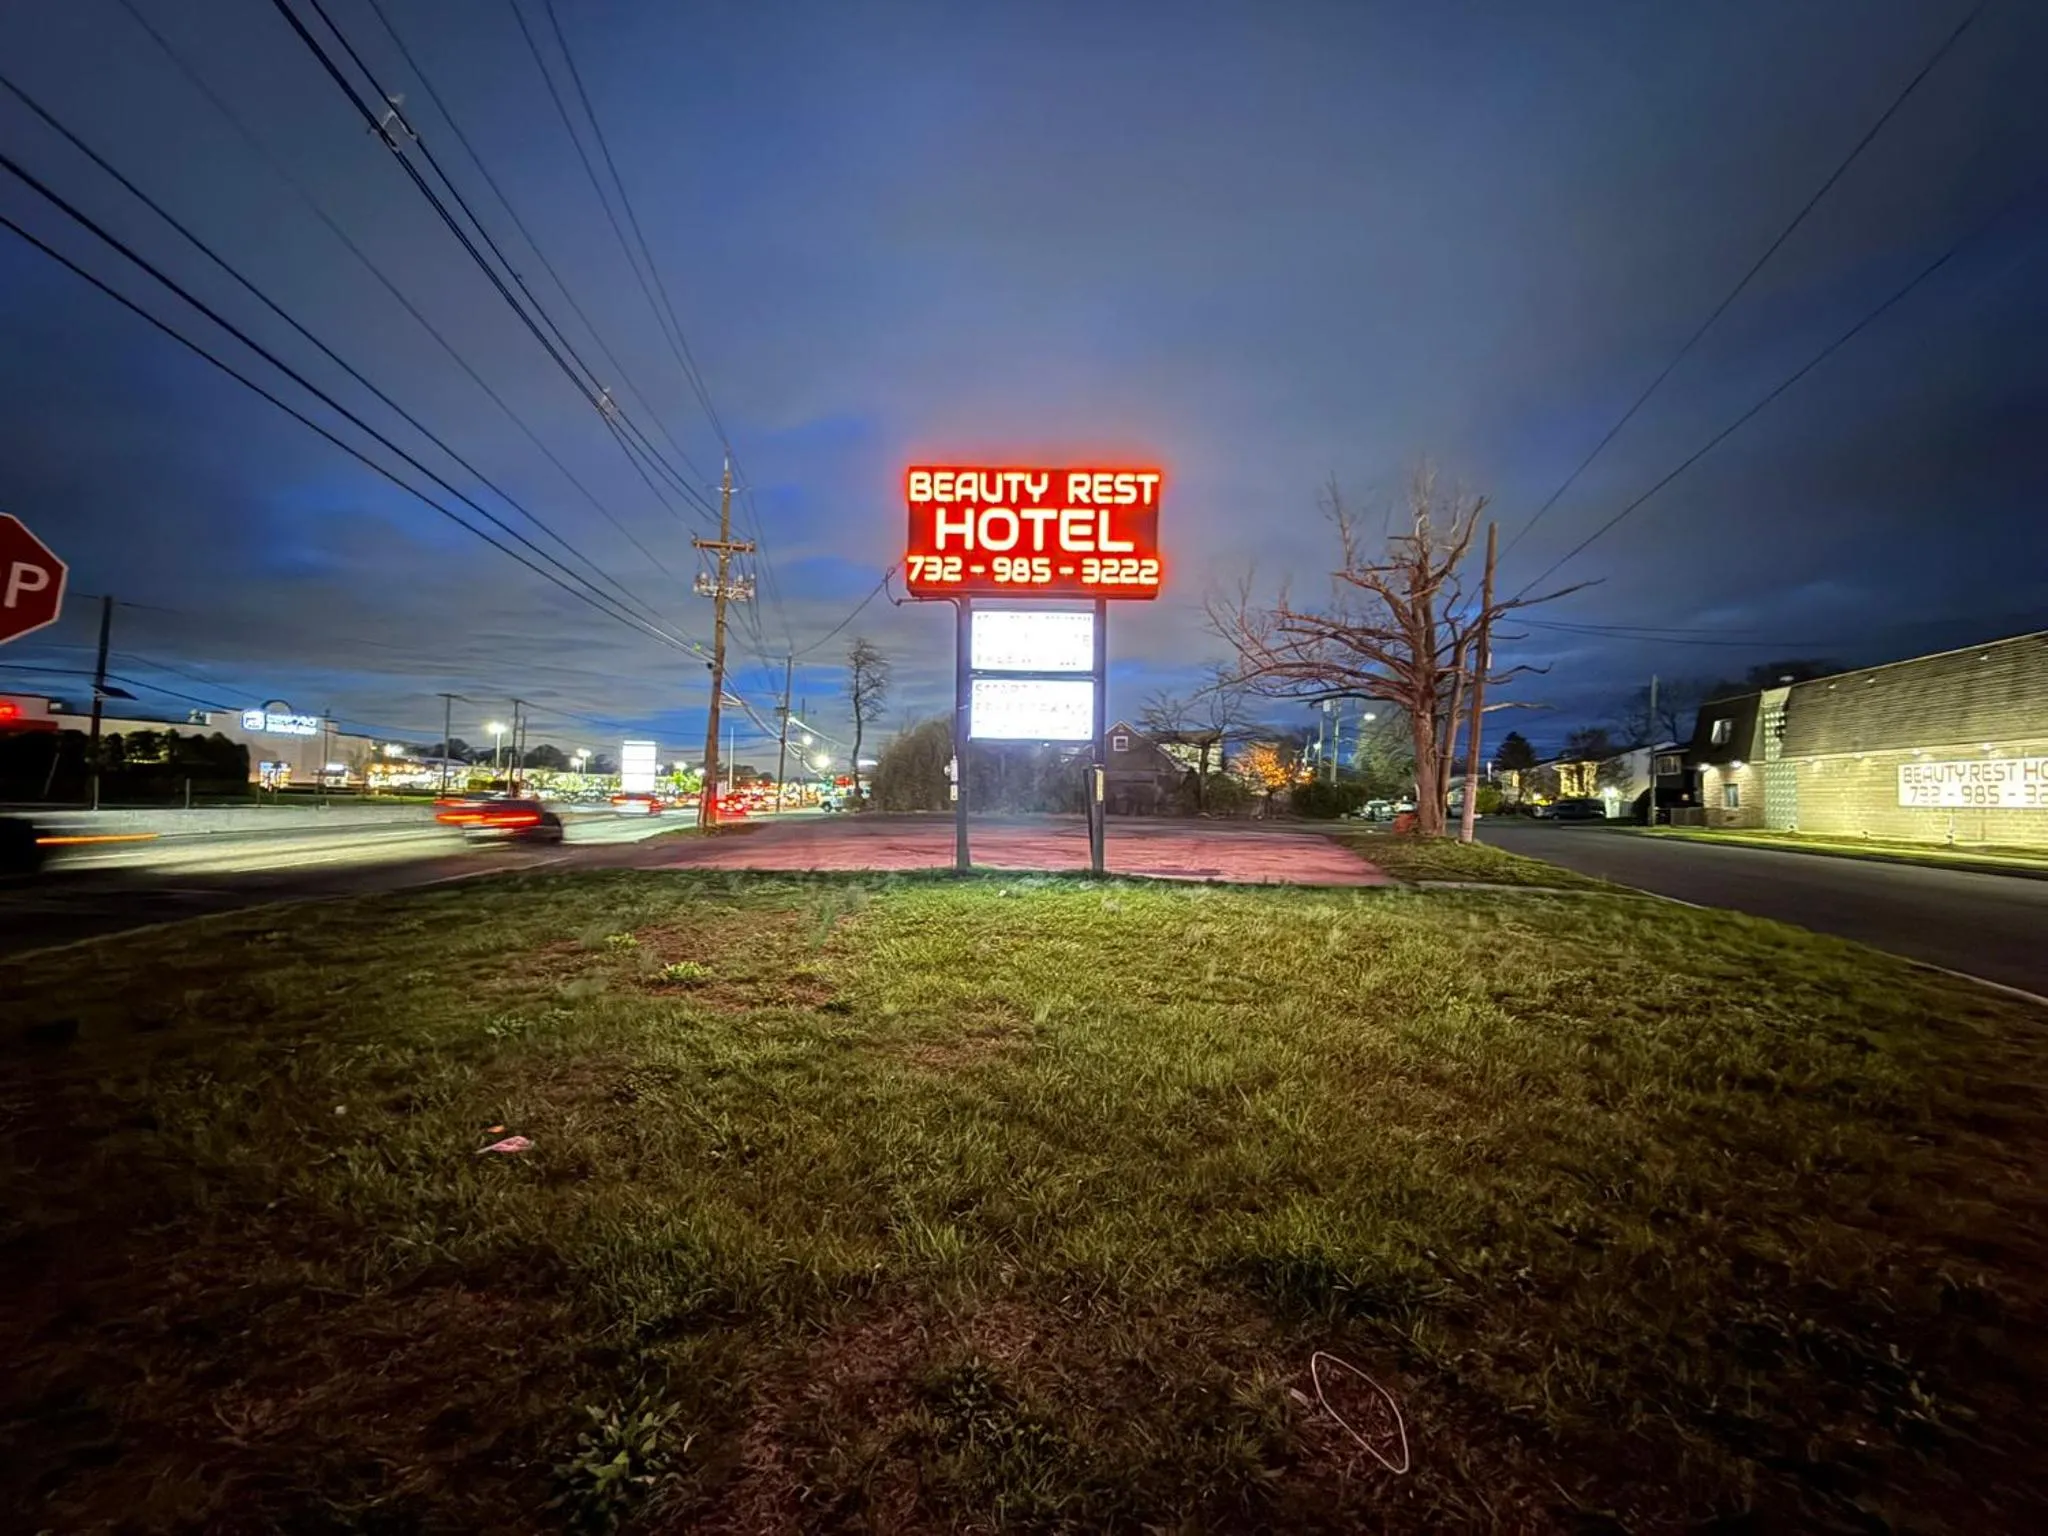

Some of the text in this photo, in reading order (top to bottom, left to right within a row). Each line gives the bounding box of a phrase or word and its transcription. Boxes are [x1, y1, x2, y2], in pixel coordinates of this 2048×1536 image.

[908, 471, 1159, 504] BEAUTY REST
[935, 507, 1134, 552] HOTEL
[907, 555, 962, 583] 732
[992, 557, 1051, 583] 985
[1081, 558, 1159, 585] 3222
[1961, 784, 2000, 804] 985
